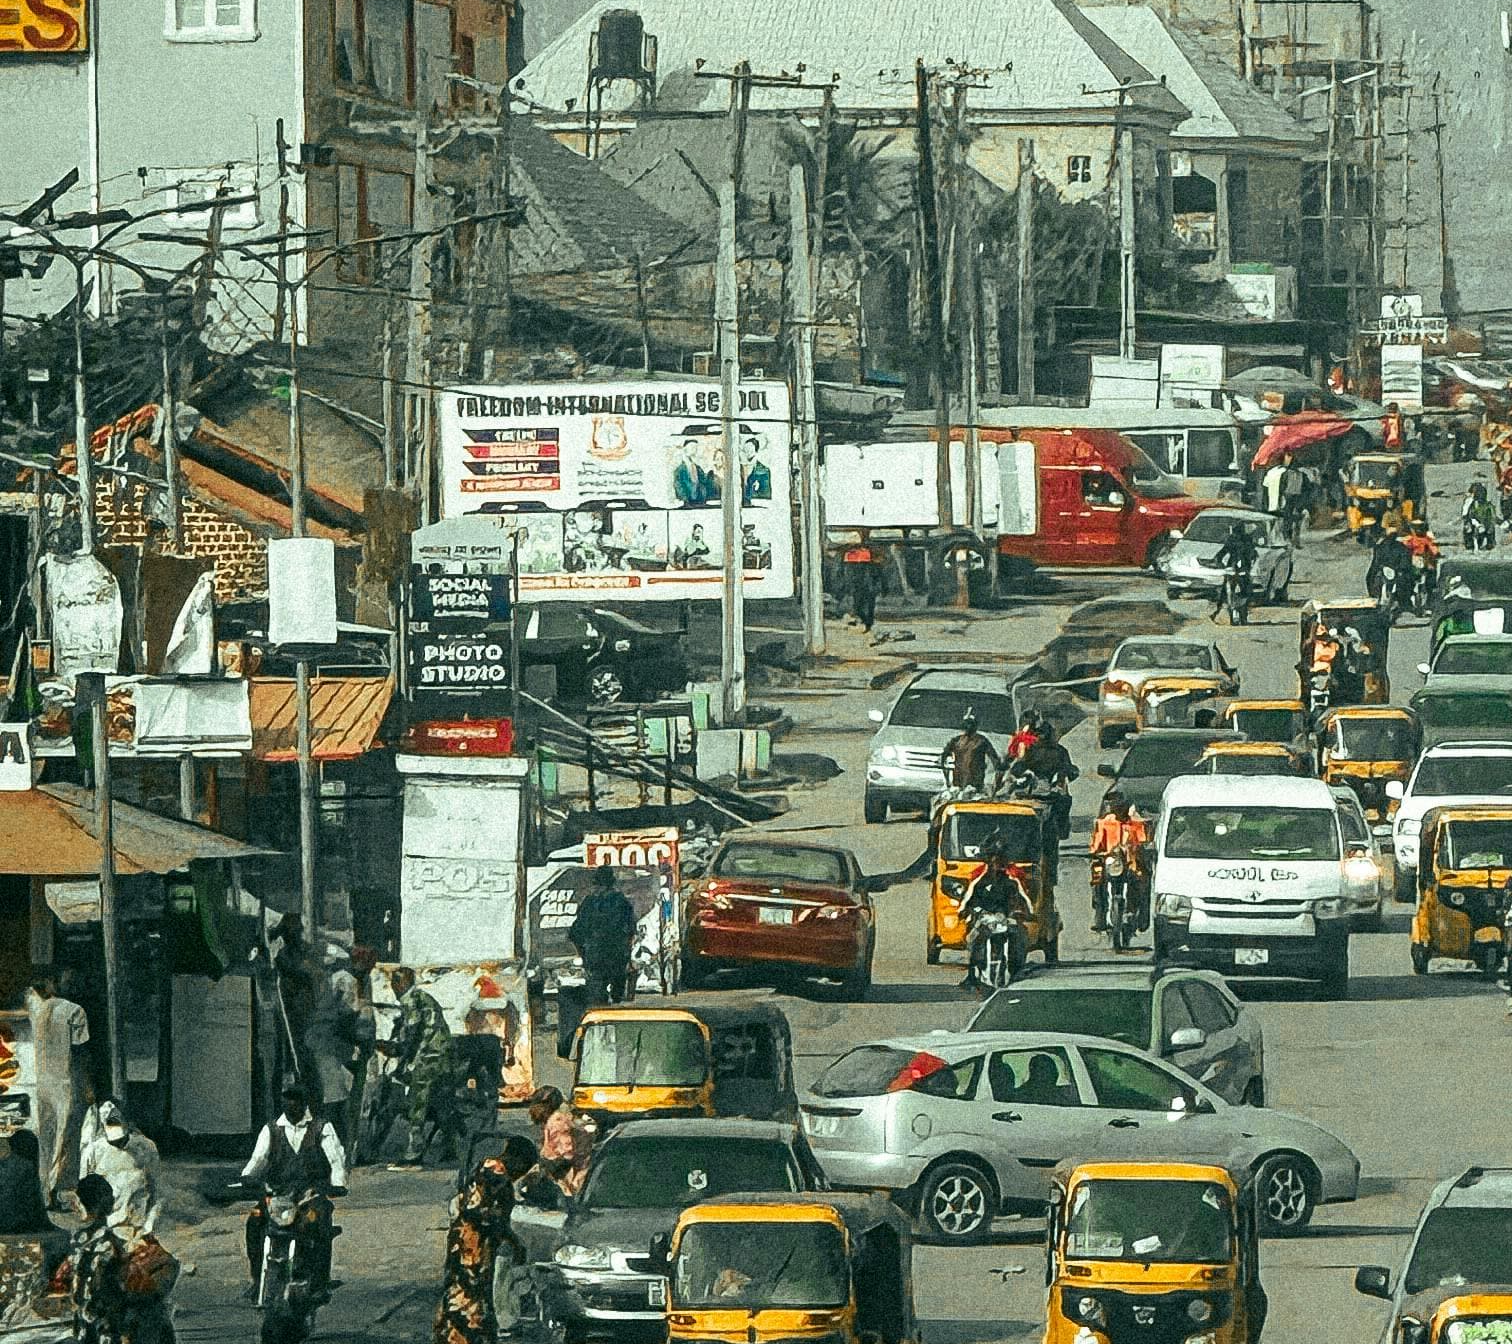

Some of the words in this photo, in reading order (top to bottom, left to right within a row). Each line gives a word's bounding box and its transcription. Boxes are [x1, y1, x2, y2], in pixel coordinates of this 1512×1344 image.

[695, 390, 770, 412] SCOOL
[428, 577, 493, 592] SOCIAL
[424, 644, 504, 662] PHOTO
[420, 665, 506, 683] STUDIO
